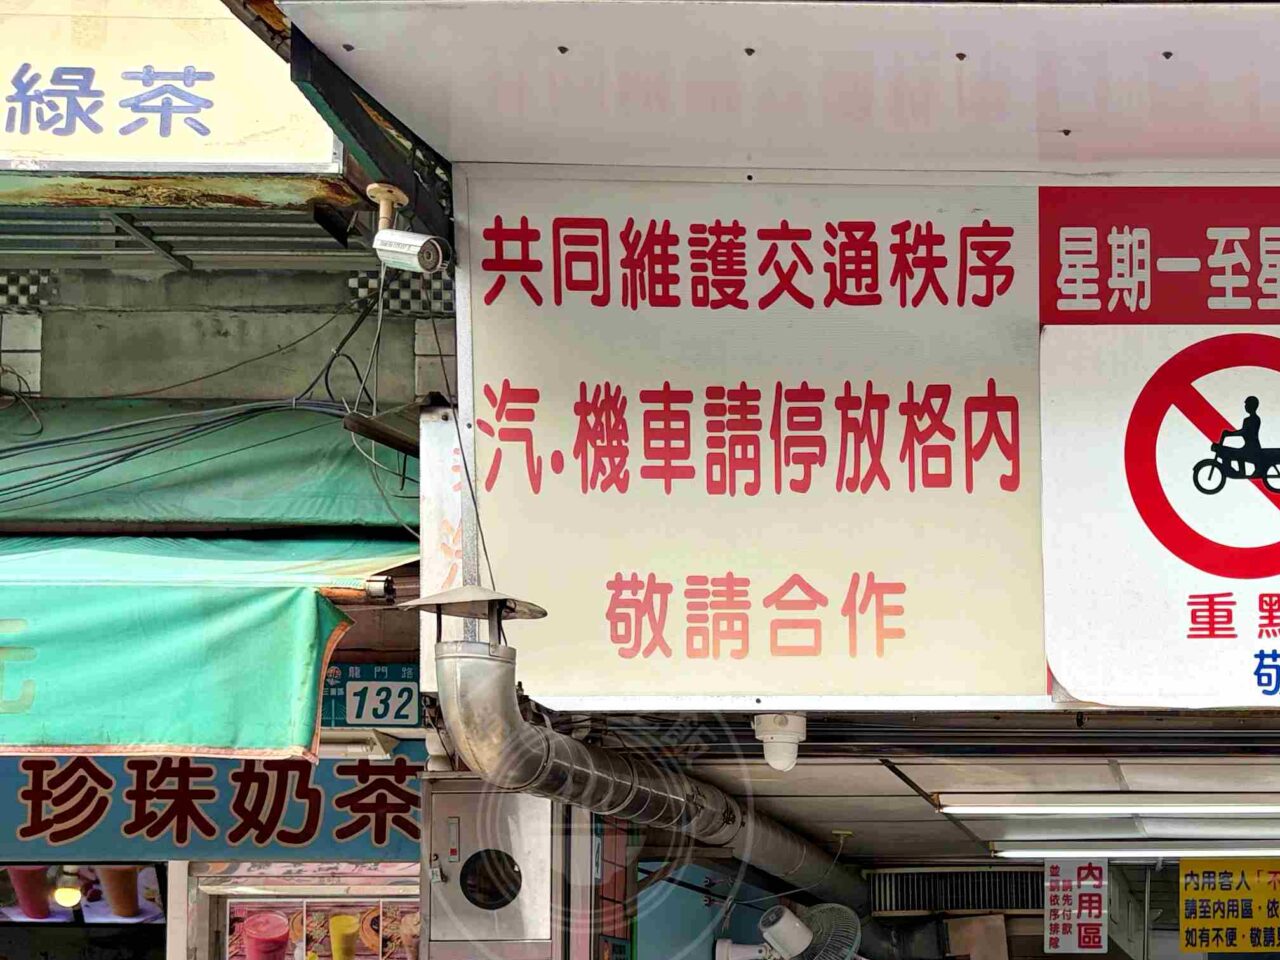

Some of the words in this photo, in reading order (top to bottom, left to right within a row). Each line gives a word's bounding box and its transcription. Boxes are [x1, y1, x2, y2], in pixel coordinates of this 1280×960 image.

[5, 63, 215, 137] 綠茶
[482, 215, 1015, 310] 共同維護交通秩序
[605, 571, 907, 660] 敬請合作
[348, 666, 414, 679] 龍門路
[352, 686, 413, 720] 132
[19, 757, 421, 846] 珍珠奶茶
[1077, 862, 1103, 949] 內用區
